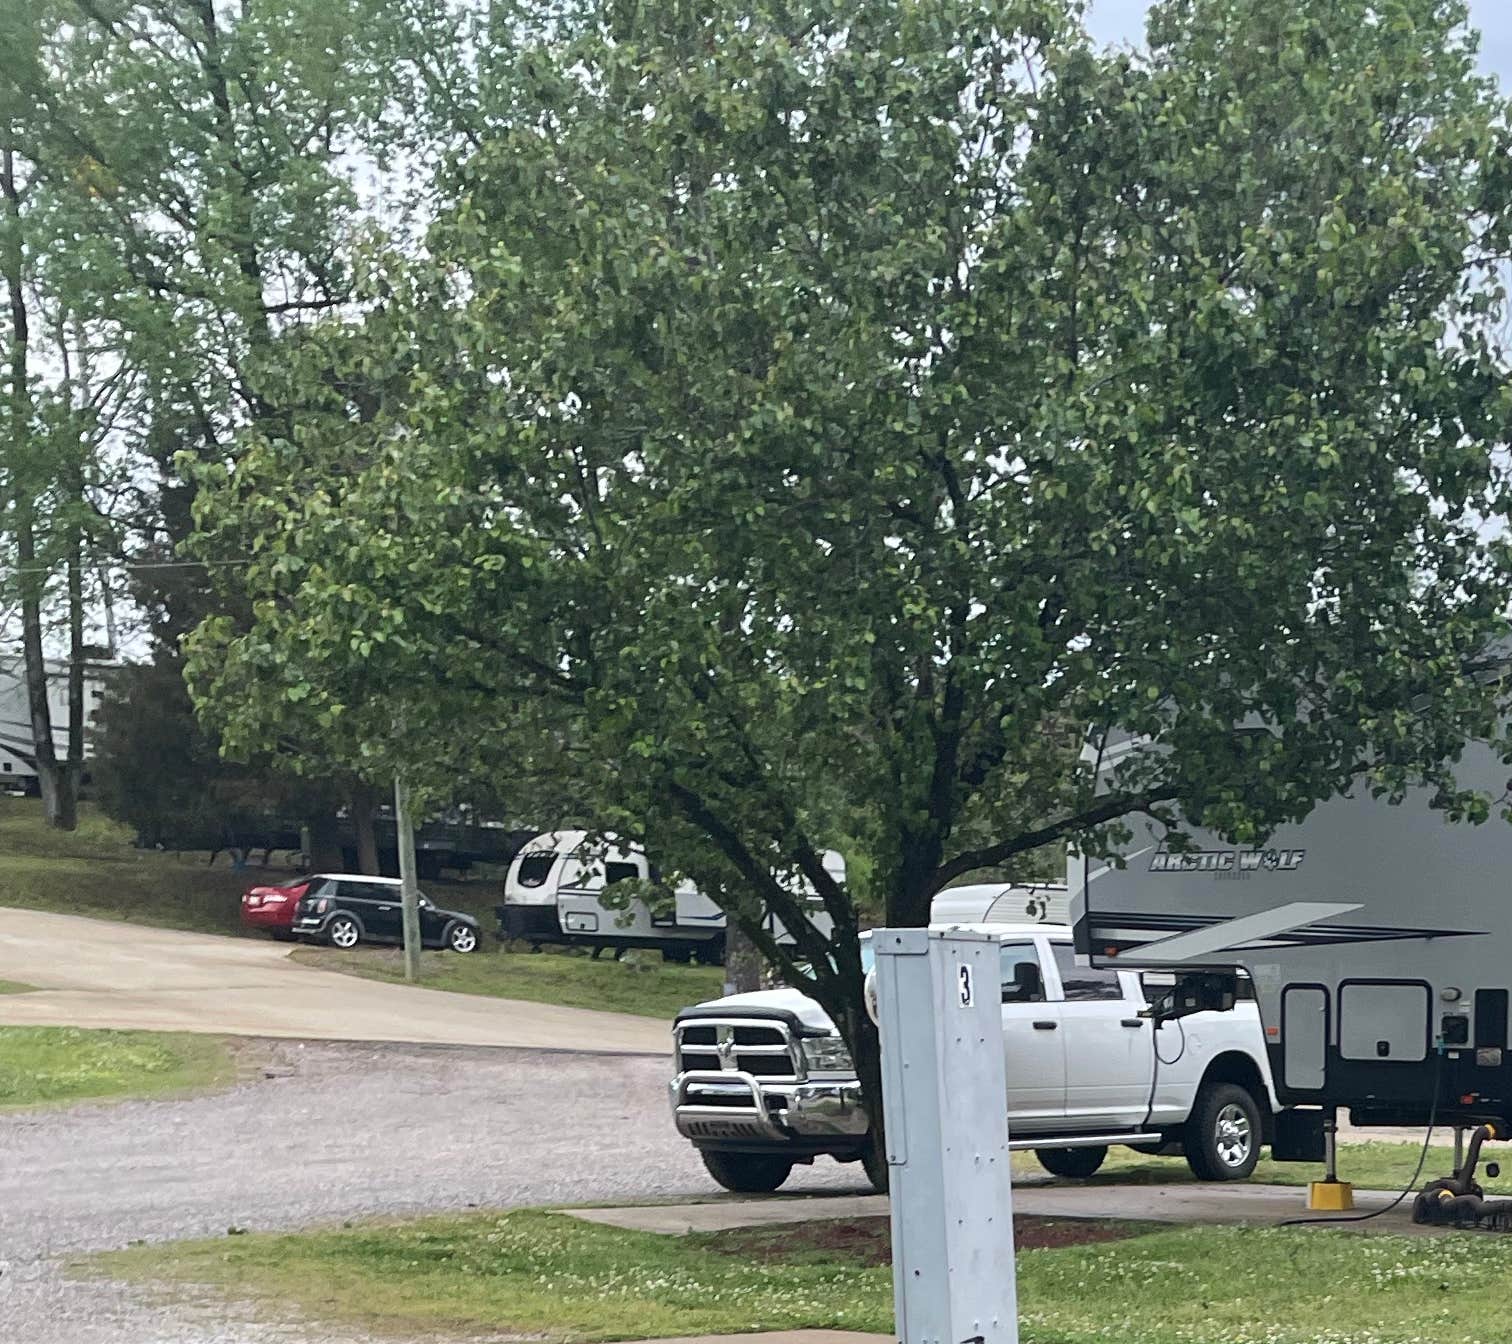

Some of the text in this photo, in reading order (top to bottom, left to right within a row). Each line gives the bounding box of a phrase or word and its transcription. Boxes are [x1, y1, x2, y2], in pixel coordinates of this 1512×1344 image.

[1149, 849, 1306, 871] ARCTIC WOLF
[960, 965, 970, 1006] 3
